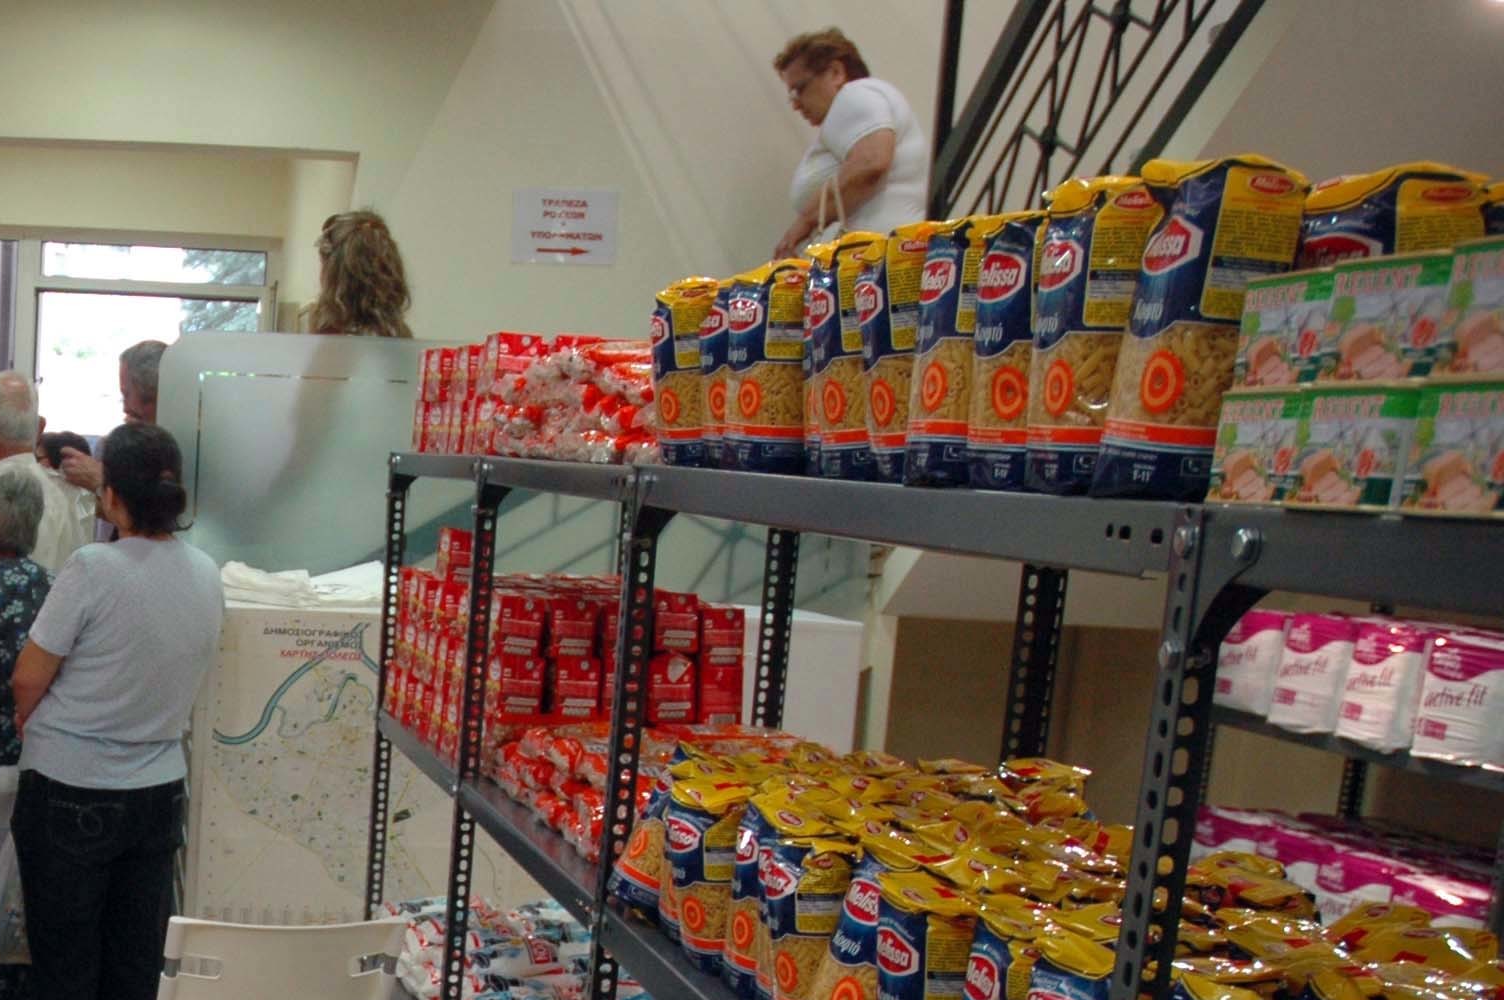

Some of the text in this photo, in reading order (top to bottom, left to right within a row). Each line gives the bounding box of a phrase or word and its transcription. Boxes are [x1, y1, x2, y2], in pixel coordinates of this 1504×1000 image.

[980, 262, 1020, 288] elissa
[263, 627, 361, 638] ΔΗΜΟΣΙΟΓΡΑΦΙΚΟ
[296, 638, 361, 649] ΟΡΓΑΝΙΣΜΟ
[850, 885, 879, 916] Meliss
[879, 933, 909, 967] elissa
